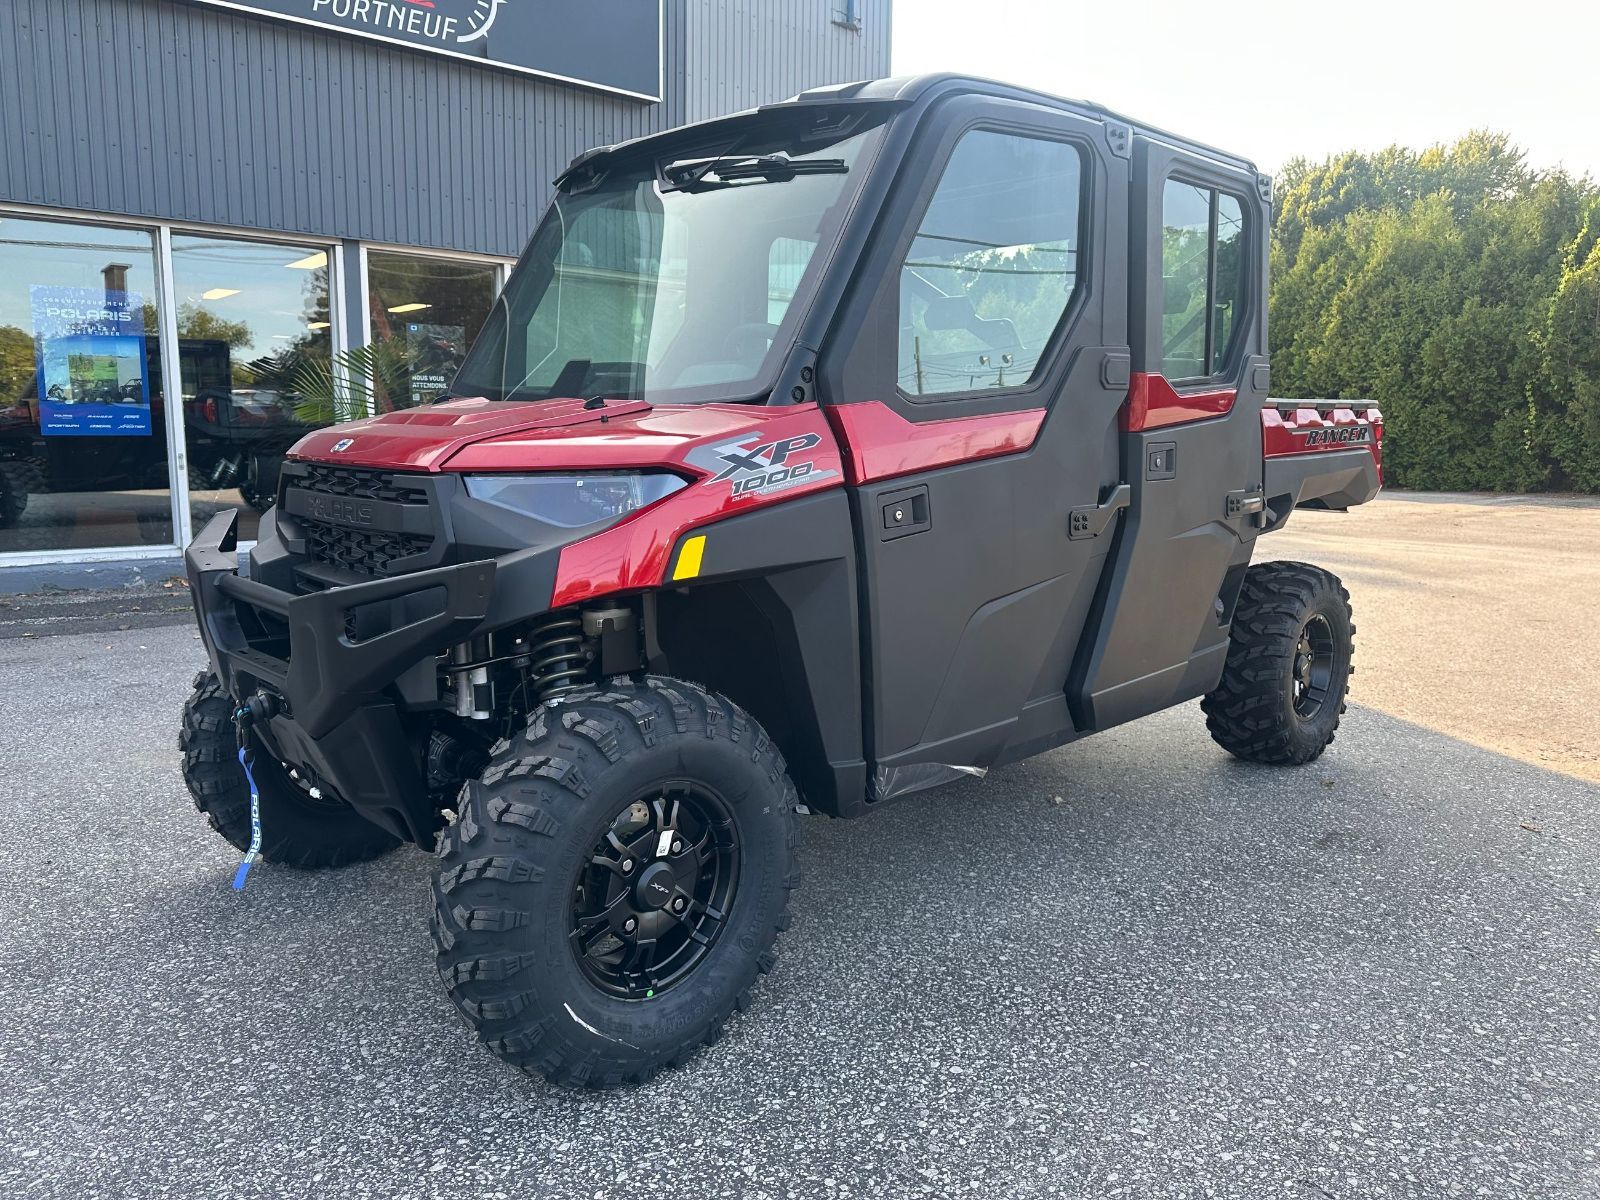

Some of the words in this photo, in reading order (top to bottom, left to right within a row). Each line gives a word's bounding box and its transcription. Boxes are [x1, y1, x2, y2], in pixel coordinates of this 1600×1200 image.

[312, 0, 458, 40] PORTNEUF
[46, 307, 132, 322] POLARIS
[1305, 427, 1369, 446] RANGER
[701, 432, 822, 487] XP
[731, 461, 813, 497] 1000
[307, 496, 373, 525] POLARIS
[244, 793, 261, 864] POLARIS
[650, 882, 670, 894] XP
